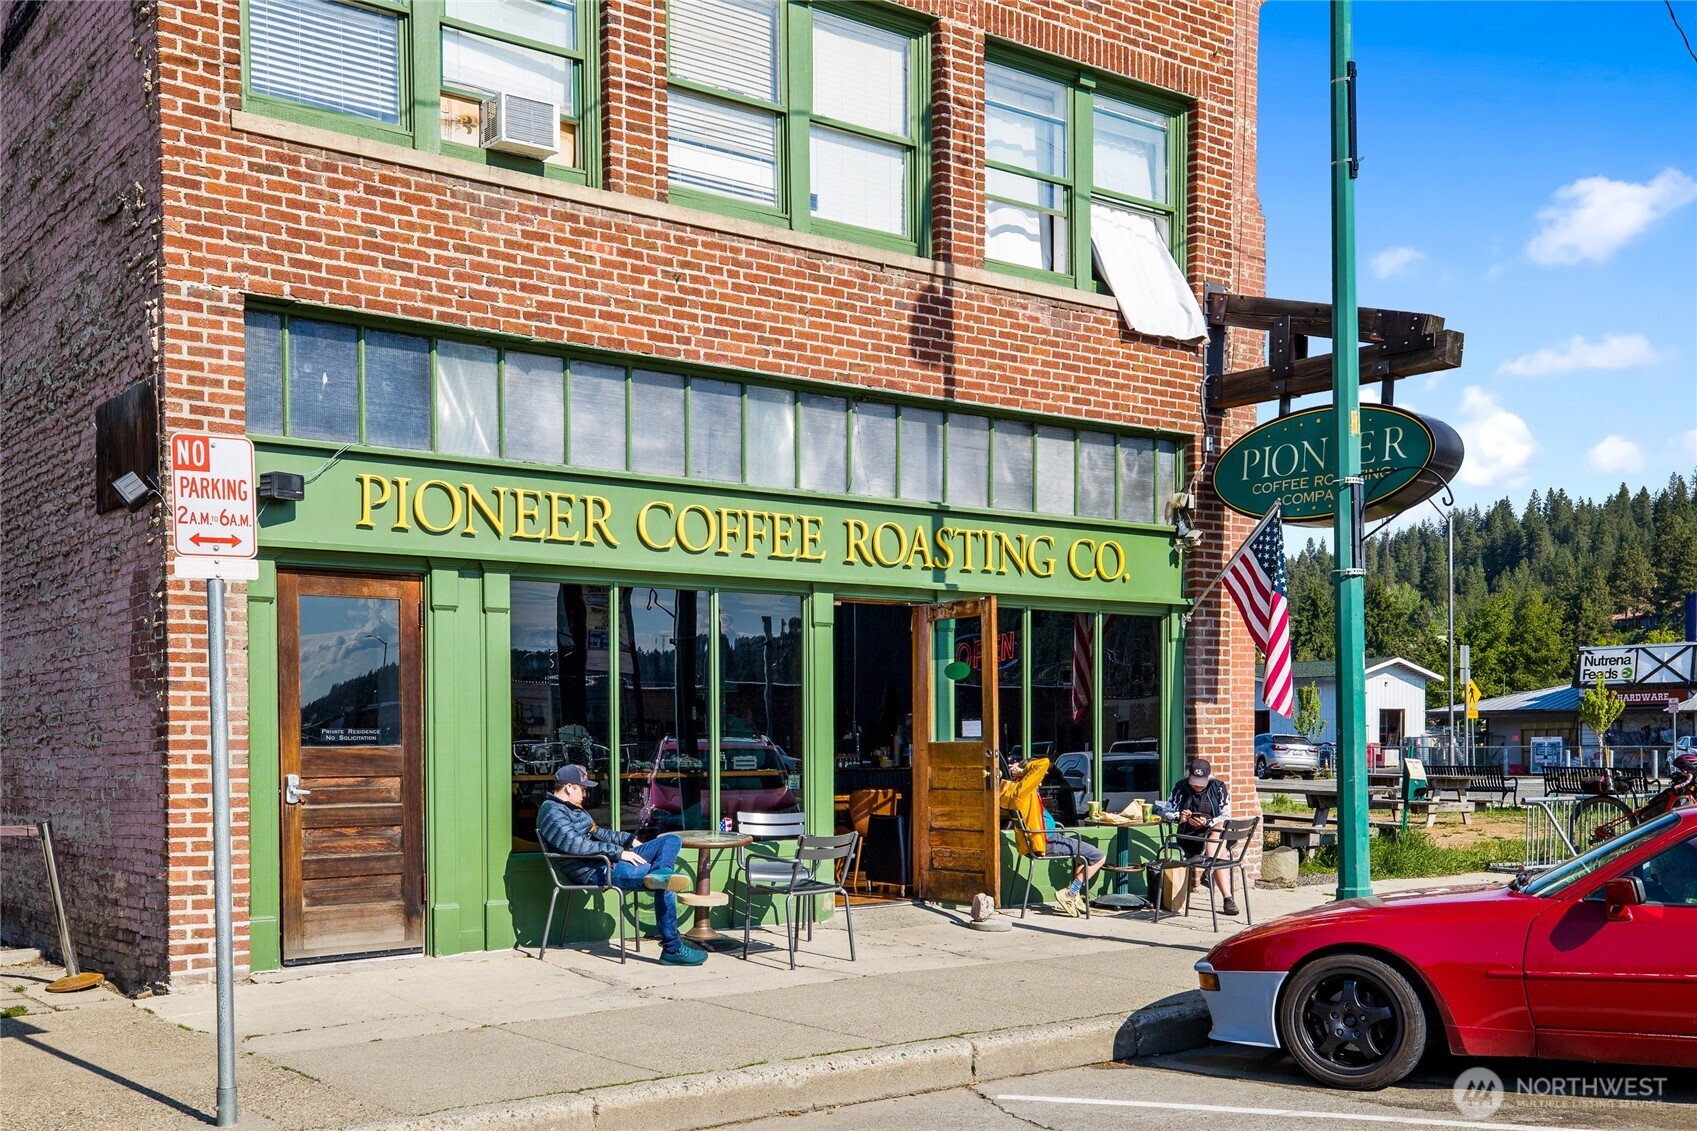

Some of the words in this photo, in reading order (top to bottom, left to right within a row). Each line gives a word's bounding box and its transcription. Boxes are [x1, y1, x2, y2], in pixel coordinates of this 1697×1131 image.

[176, 439, 205, 467] NO
[1242, 426, 1408, 481] PIONER
[180, 476, 248, 502] PARKING
[1252, 477, 1308, 495] COFFEE
[1314, 466, 1392, 487] ROING
[1281, 489, 1334, 506] COMPA
[211, 515, 218, 523] TO
[355, 473, 620, 547] PIONEER
[637, 501, 827, 561] COFFEE
[844, 518, 1057, 578] ROASTING
[1067, 537, 1131, 582] CO.
[956, 631, 1015, 669] OPN
[1584, 655, 1632, 667] Nutrena
[1617, 692, 1670, 702] HARDWARE
